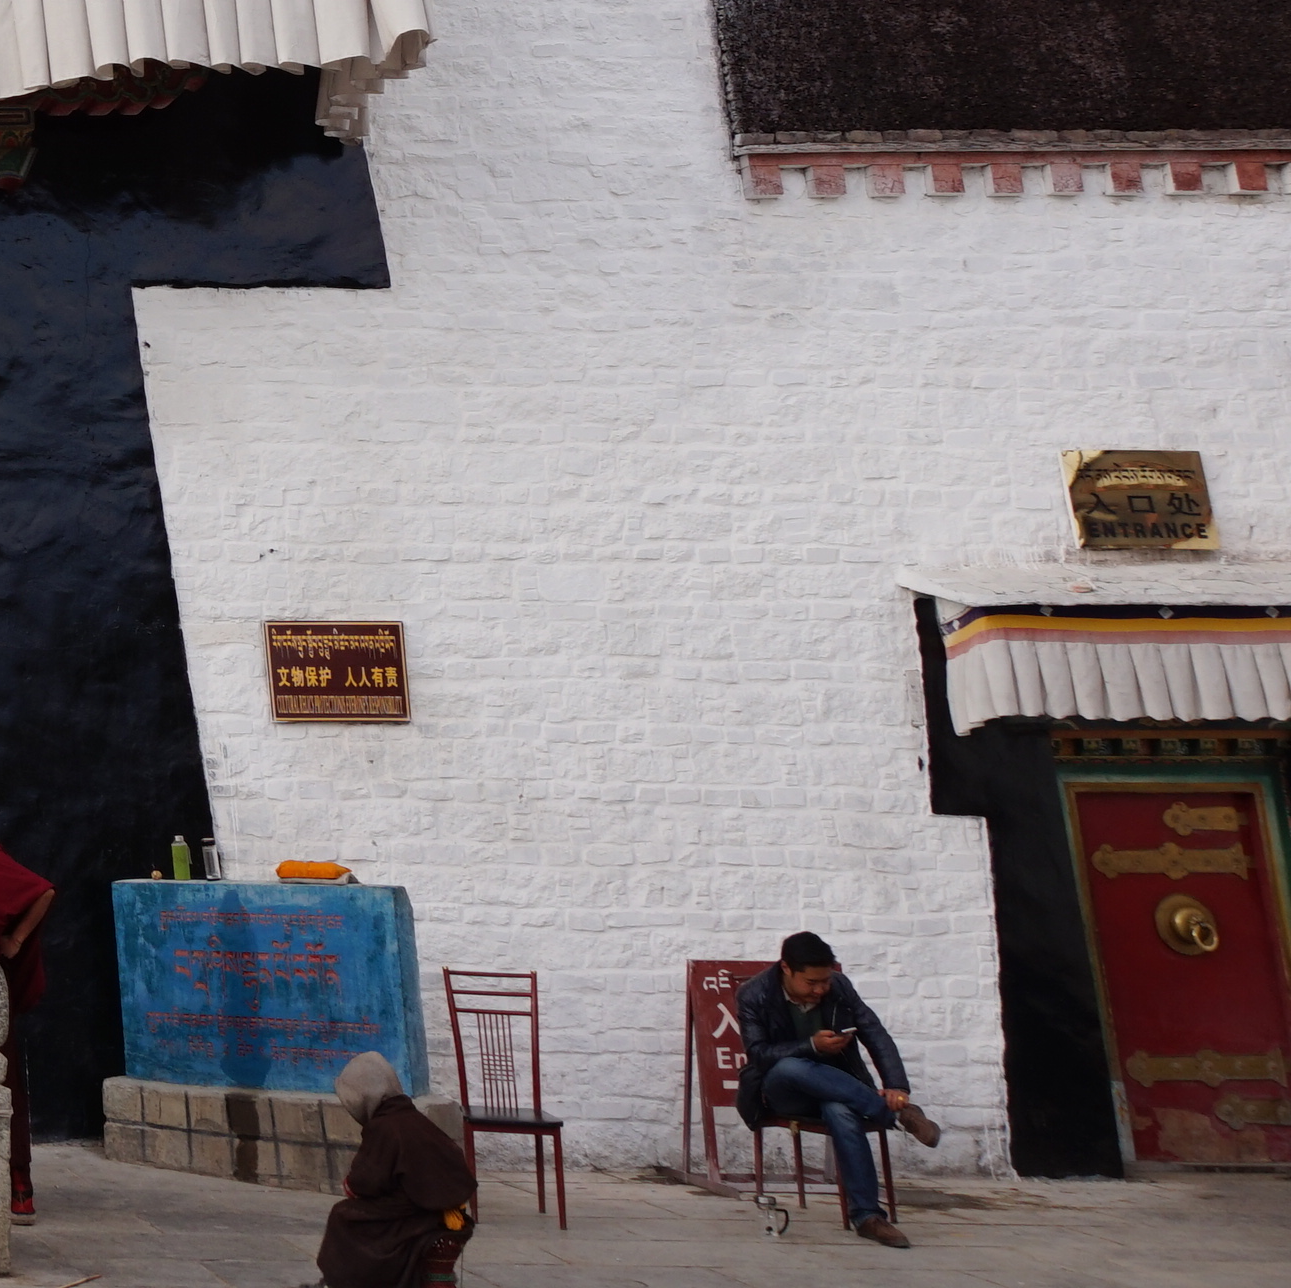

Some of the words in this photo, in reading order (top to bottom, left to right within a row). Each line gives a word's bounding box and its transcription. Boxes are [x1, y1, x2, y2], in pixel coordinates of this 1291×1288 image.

[1086, 492, 1202, 516] 入口处
[1089, 522, 1209, 539] ENTRANCE
[276, 666, 332, 687] 文物保护
[345, 666, 398, 688] 人人有责
[712, 1002, 741, 1039] 入
[715, 1047, 748, 1070] En
